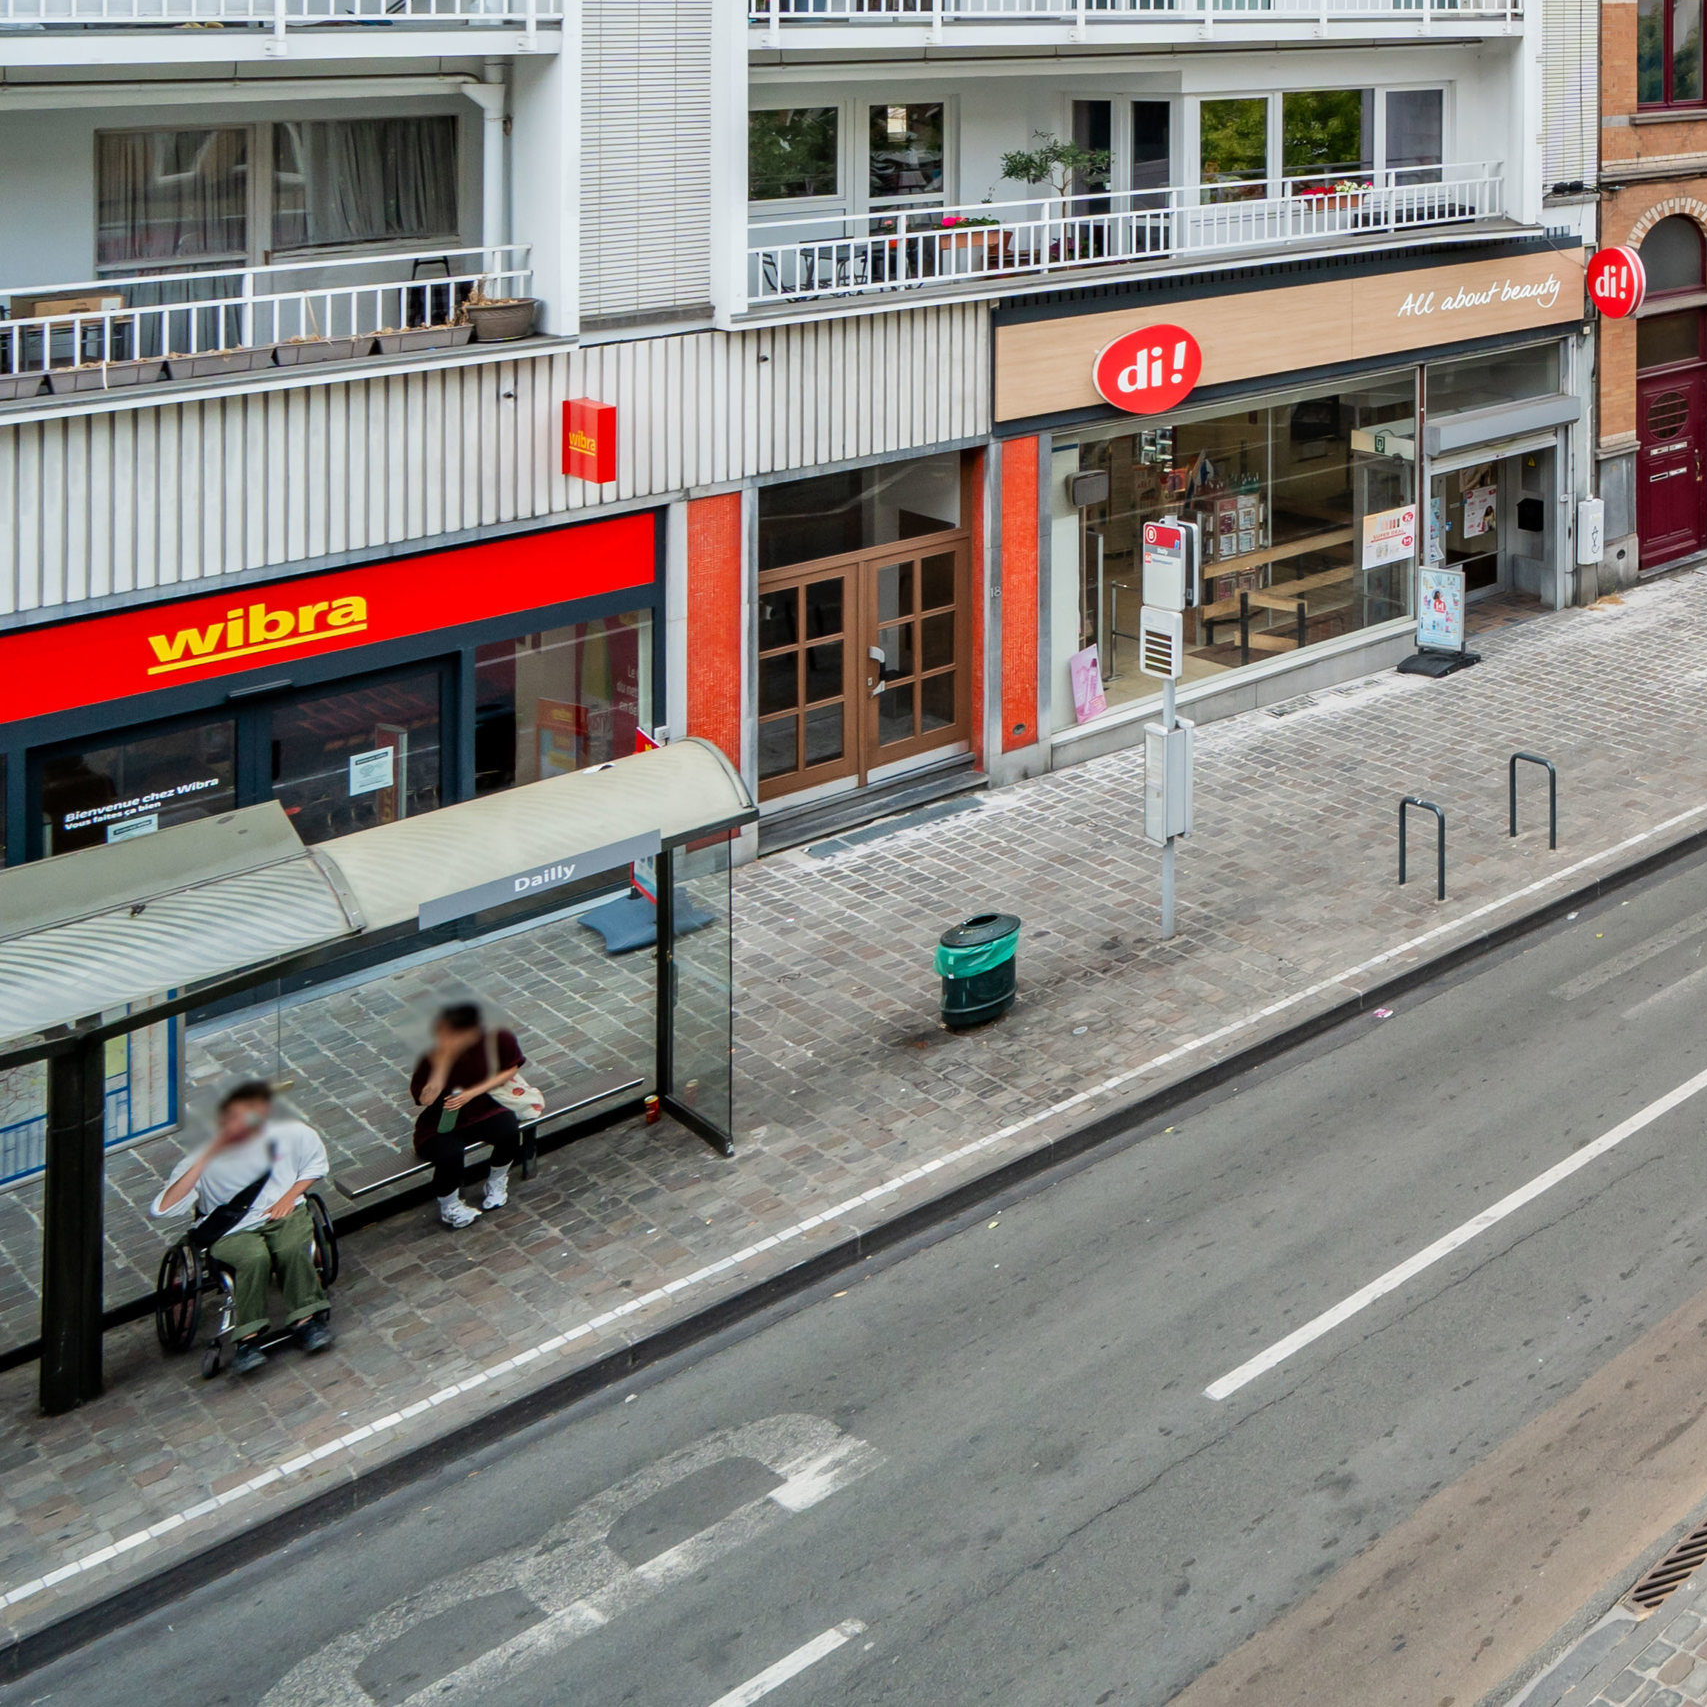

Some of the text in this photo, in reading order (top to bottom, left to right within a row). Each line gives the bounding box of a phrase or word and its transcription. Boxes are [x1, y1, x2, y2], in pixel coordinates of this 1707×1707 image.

[1397, 273, 1562, 317] All about beauty
[1595, 265, 1627, 300] di!
[1117, 341, 1186, 393] di!
[568, 430, 596, 451] wibra
[990, 586, 1001, 599] 18
[147, 596, 367, 663] wibra
[65, 777, 219, 823] Bienvenue chez Wibra
[65, 801, 162, 831] Vous faites ça bien
[514, 864, 576, 892] Dailly
